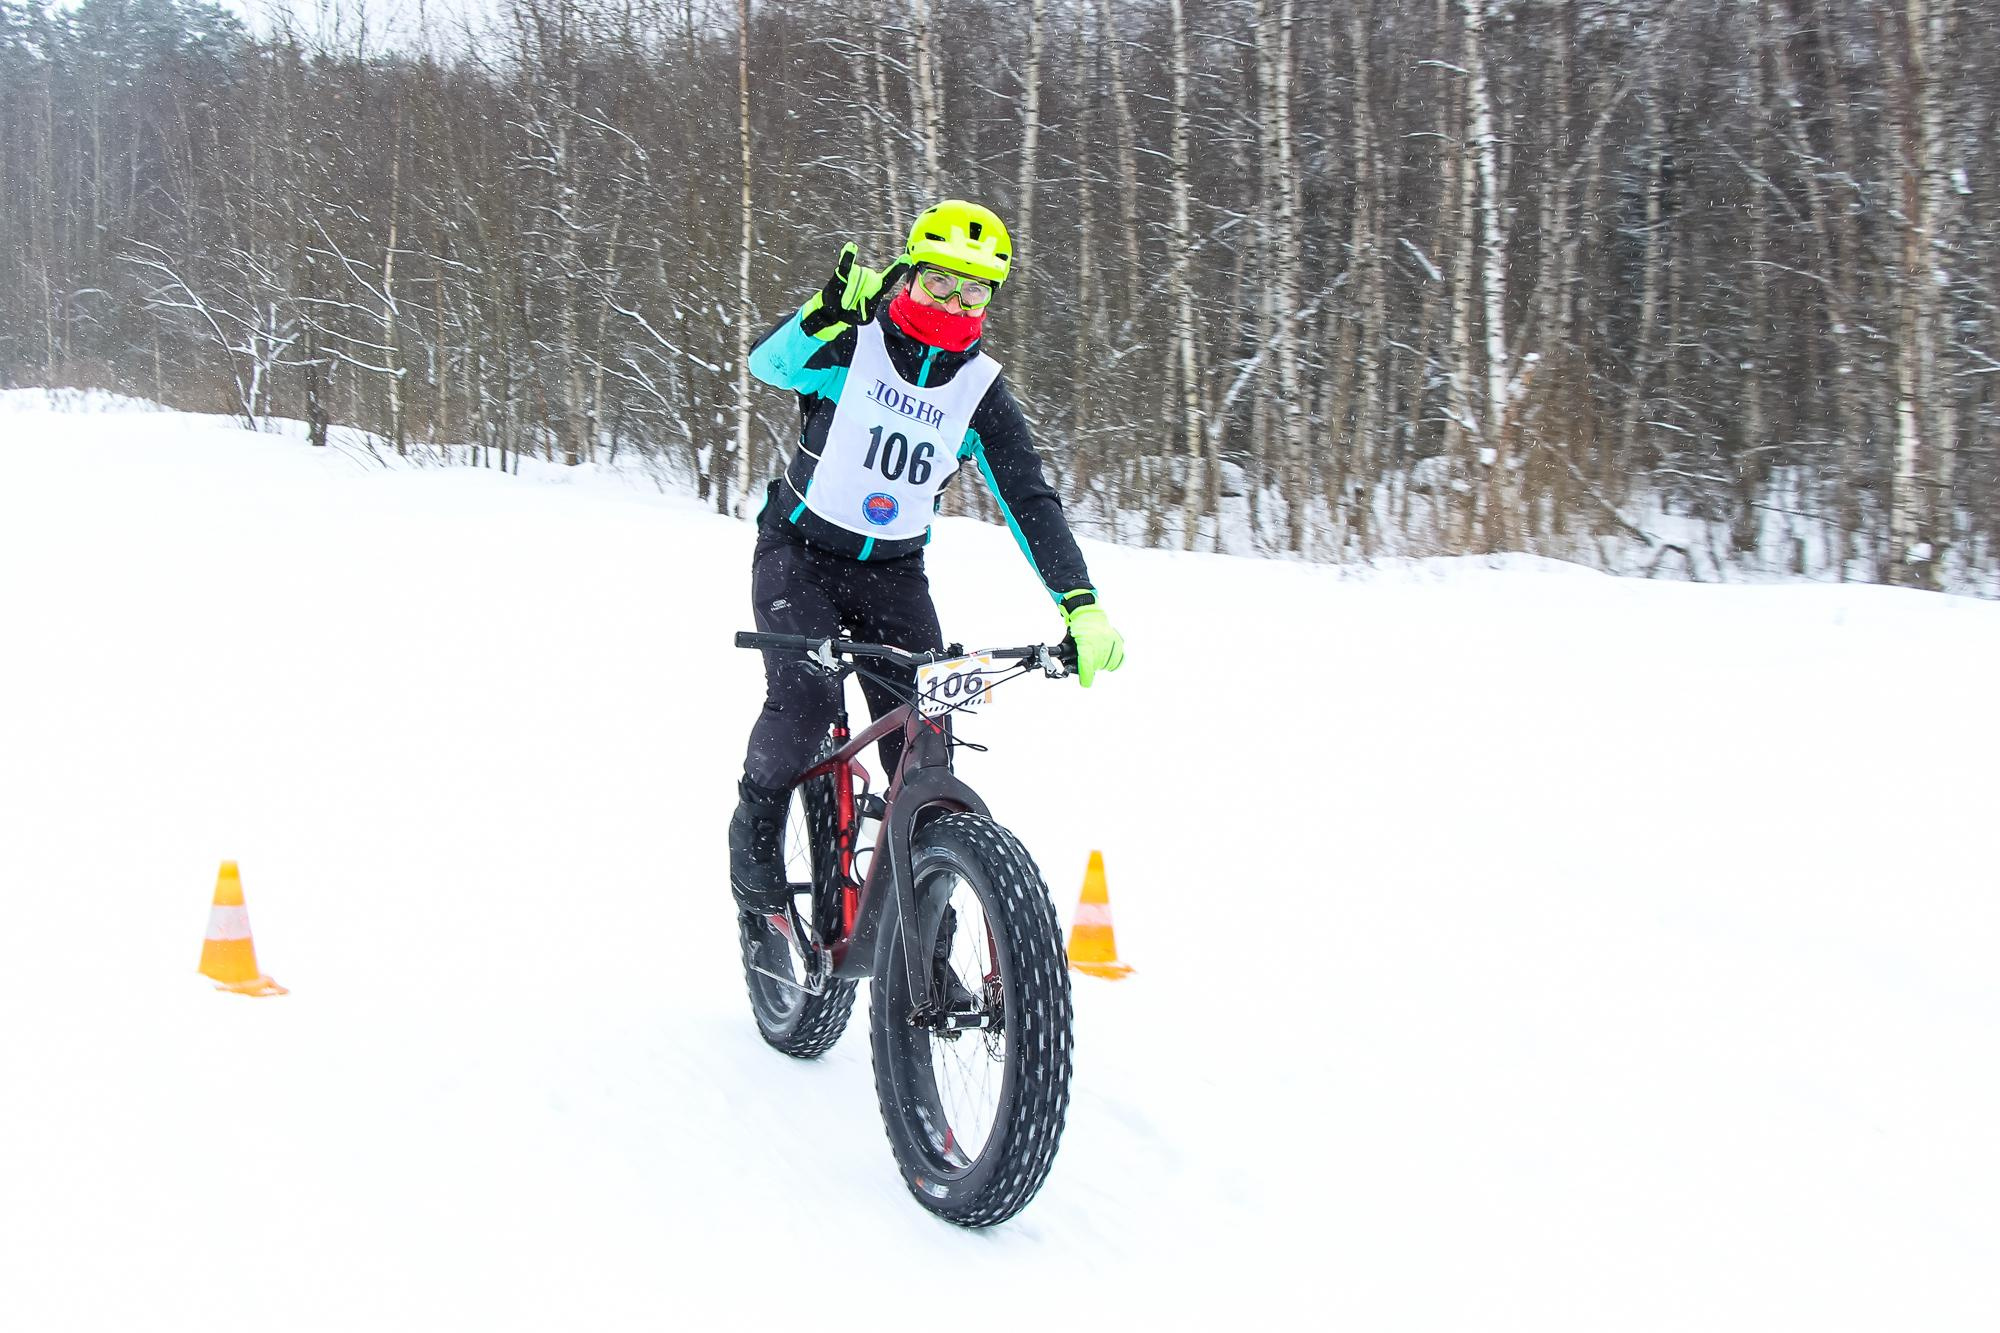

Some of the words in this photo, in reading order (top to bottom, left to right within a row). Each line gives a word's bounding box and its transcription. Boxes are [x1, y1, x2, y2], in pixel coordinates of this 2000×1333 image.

[867, 379, 946, 430] ЛОБНЯ
[863, 425, 935, 485] 106
[927, 668, 983, 702] 106
